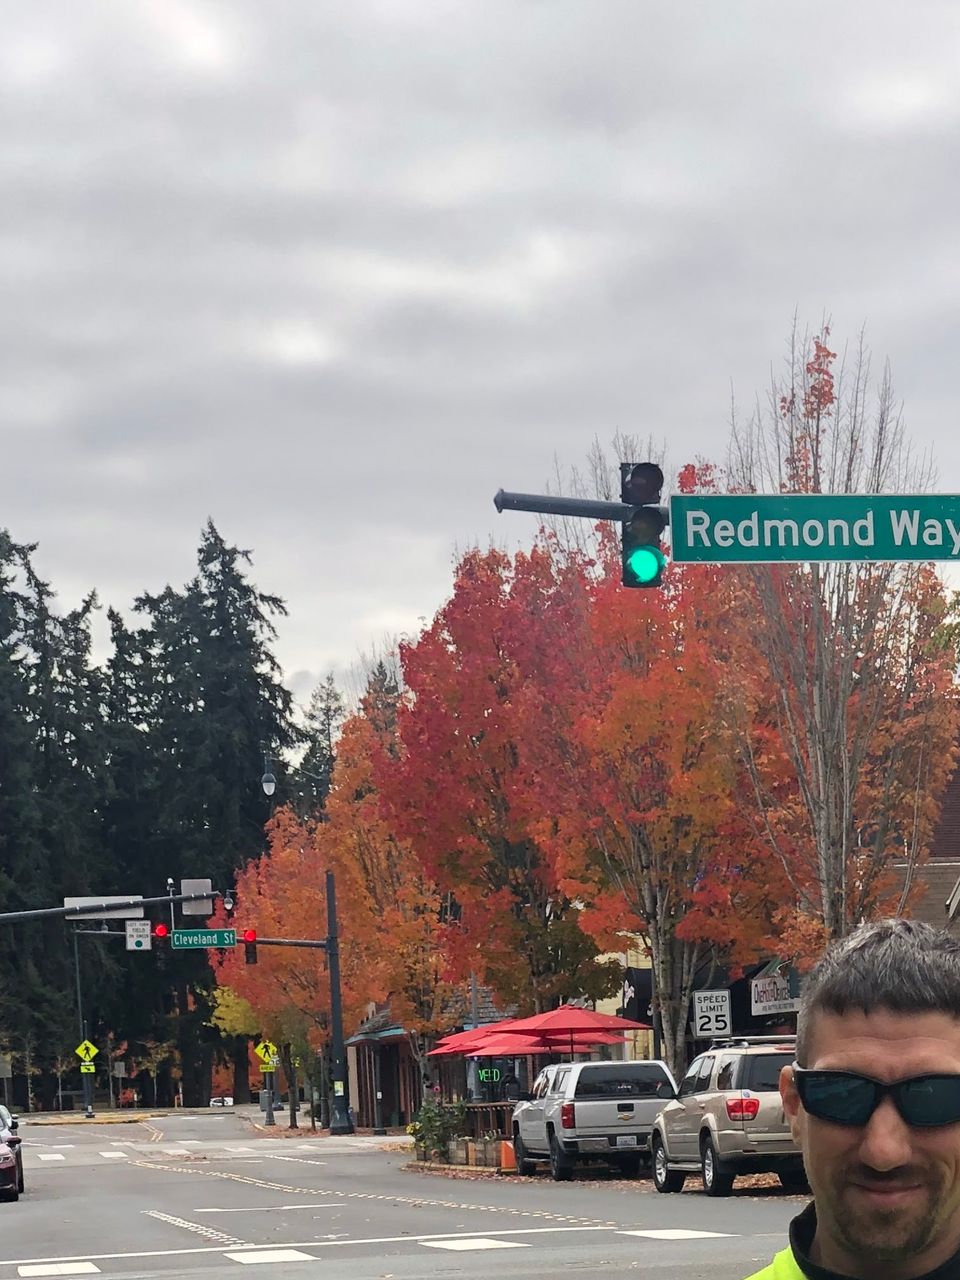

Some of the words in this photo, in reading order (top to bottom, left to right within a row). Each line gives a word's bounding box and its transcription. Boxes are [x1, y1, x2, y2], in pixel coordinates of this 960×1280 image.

[686, 510, 874, 547] Redmond
[174, 933, 217, 945] Cleveland
[224, 932, 234, 944] St
[697, 995, 728, 1003] SPEED
[700, 1004, 724, 1013] LIMIT
[699, 1014, 728, 1032] 25
